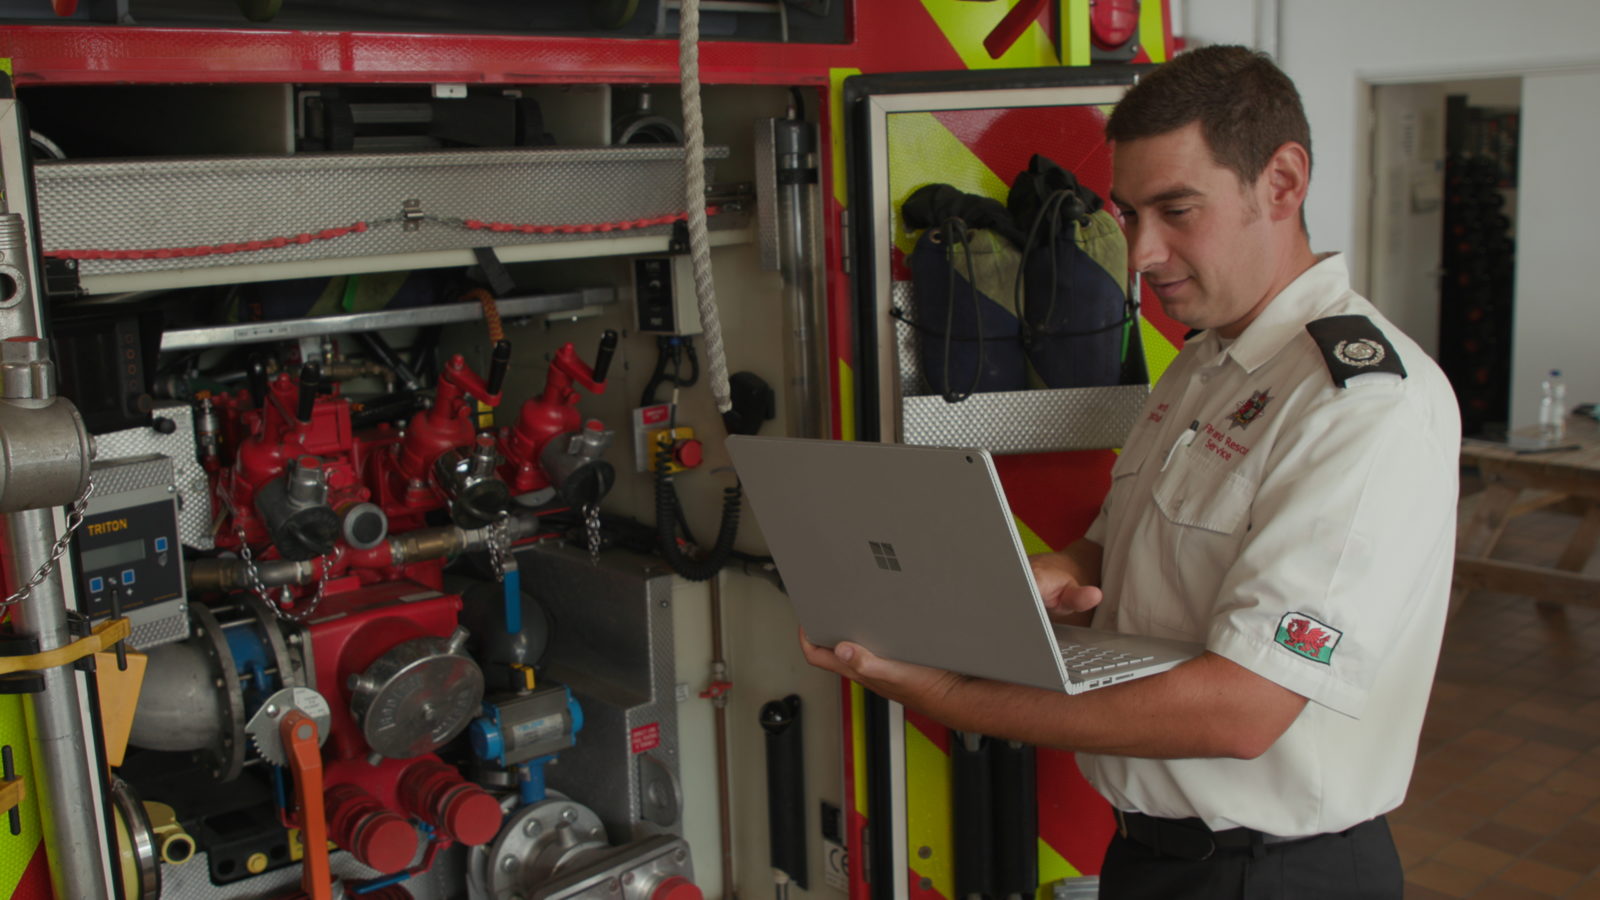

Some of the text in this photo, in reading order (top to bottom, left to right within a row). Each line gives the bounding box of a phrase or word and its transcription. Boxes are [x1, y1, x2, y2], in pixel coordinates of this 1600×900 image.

[1205, 438, 1232, 460] Service
[1225, 436, 1249, 456] Rescu
[87, 518, 128, 536] TRITON
